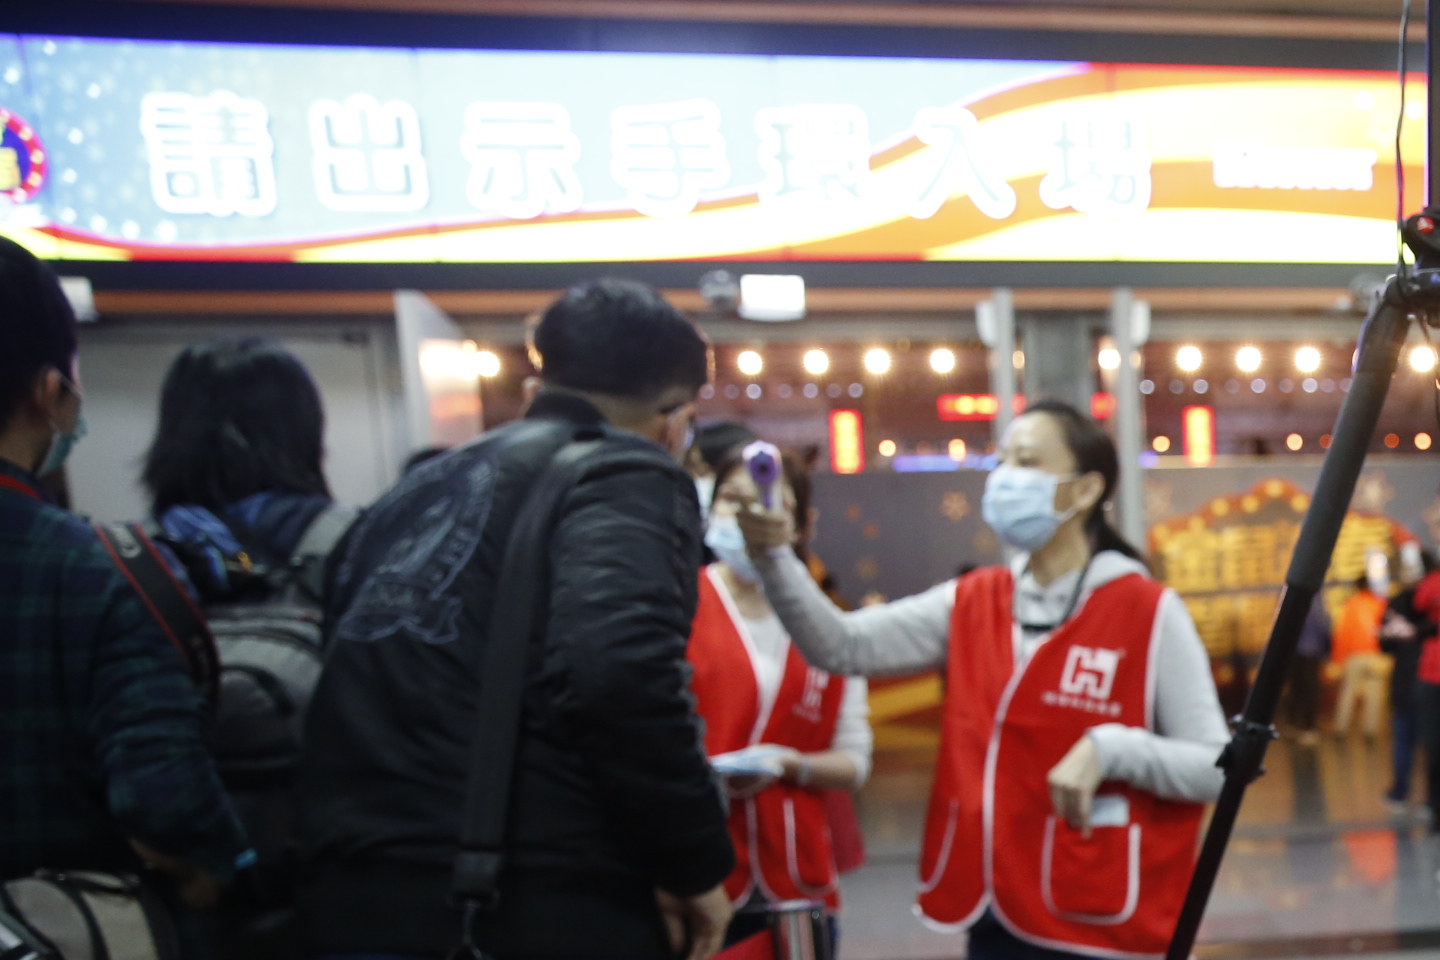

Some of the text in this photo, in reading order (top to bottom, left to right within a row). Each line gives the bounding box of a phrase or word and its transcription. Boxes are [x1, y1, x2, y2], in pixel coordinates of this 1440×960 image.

[141, 89, 1152, 220] 請出示手環入場
